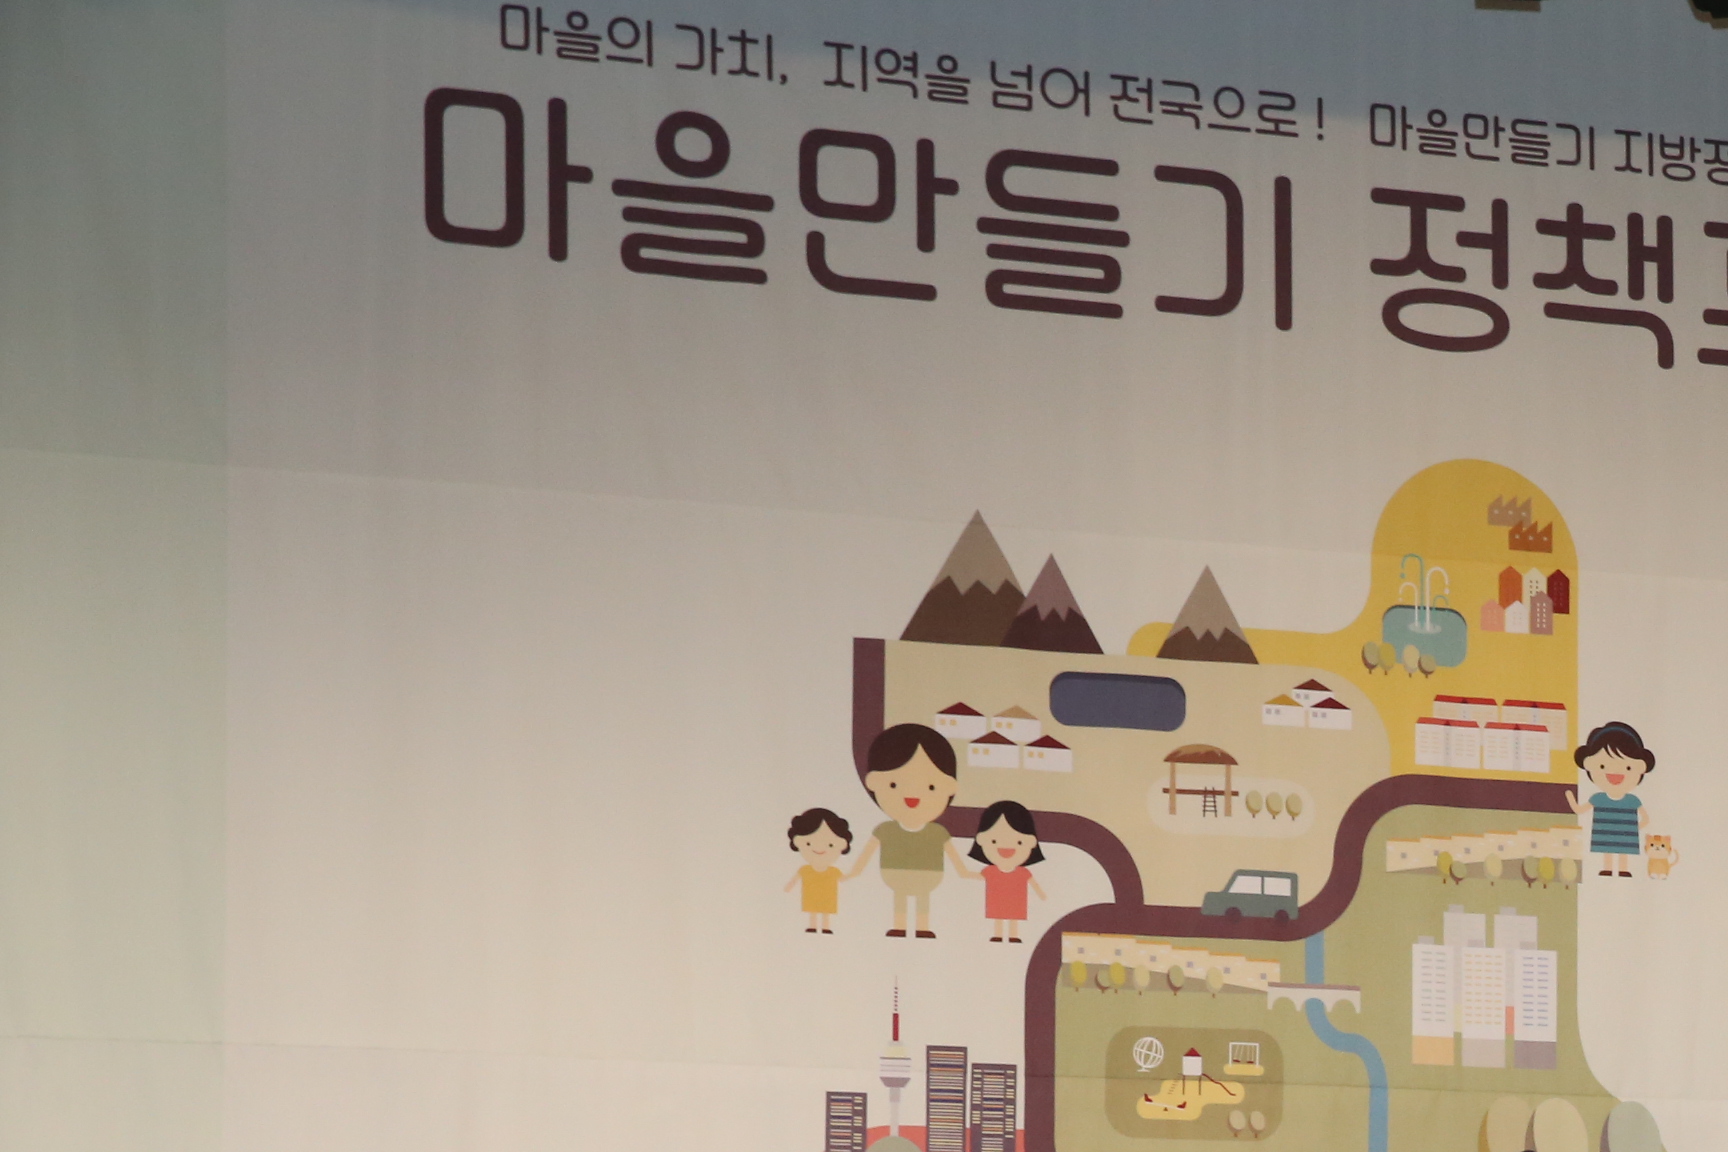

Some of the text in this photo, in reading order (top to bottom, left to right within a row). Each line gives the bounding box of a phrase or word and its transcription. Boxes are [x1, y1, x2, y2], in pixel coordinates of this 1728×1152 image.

[500, 3, 653, 67] 마을의
[675, 24, 787, 85] 가치,
[823, 41, 970, 105] 지역을
[990, 60, 1090, 116] 넘어
[1370, 103, 1595, 170] 마을만들기
[424, 87, 1292, 331] 마을만들기
